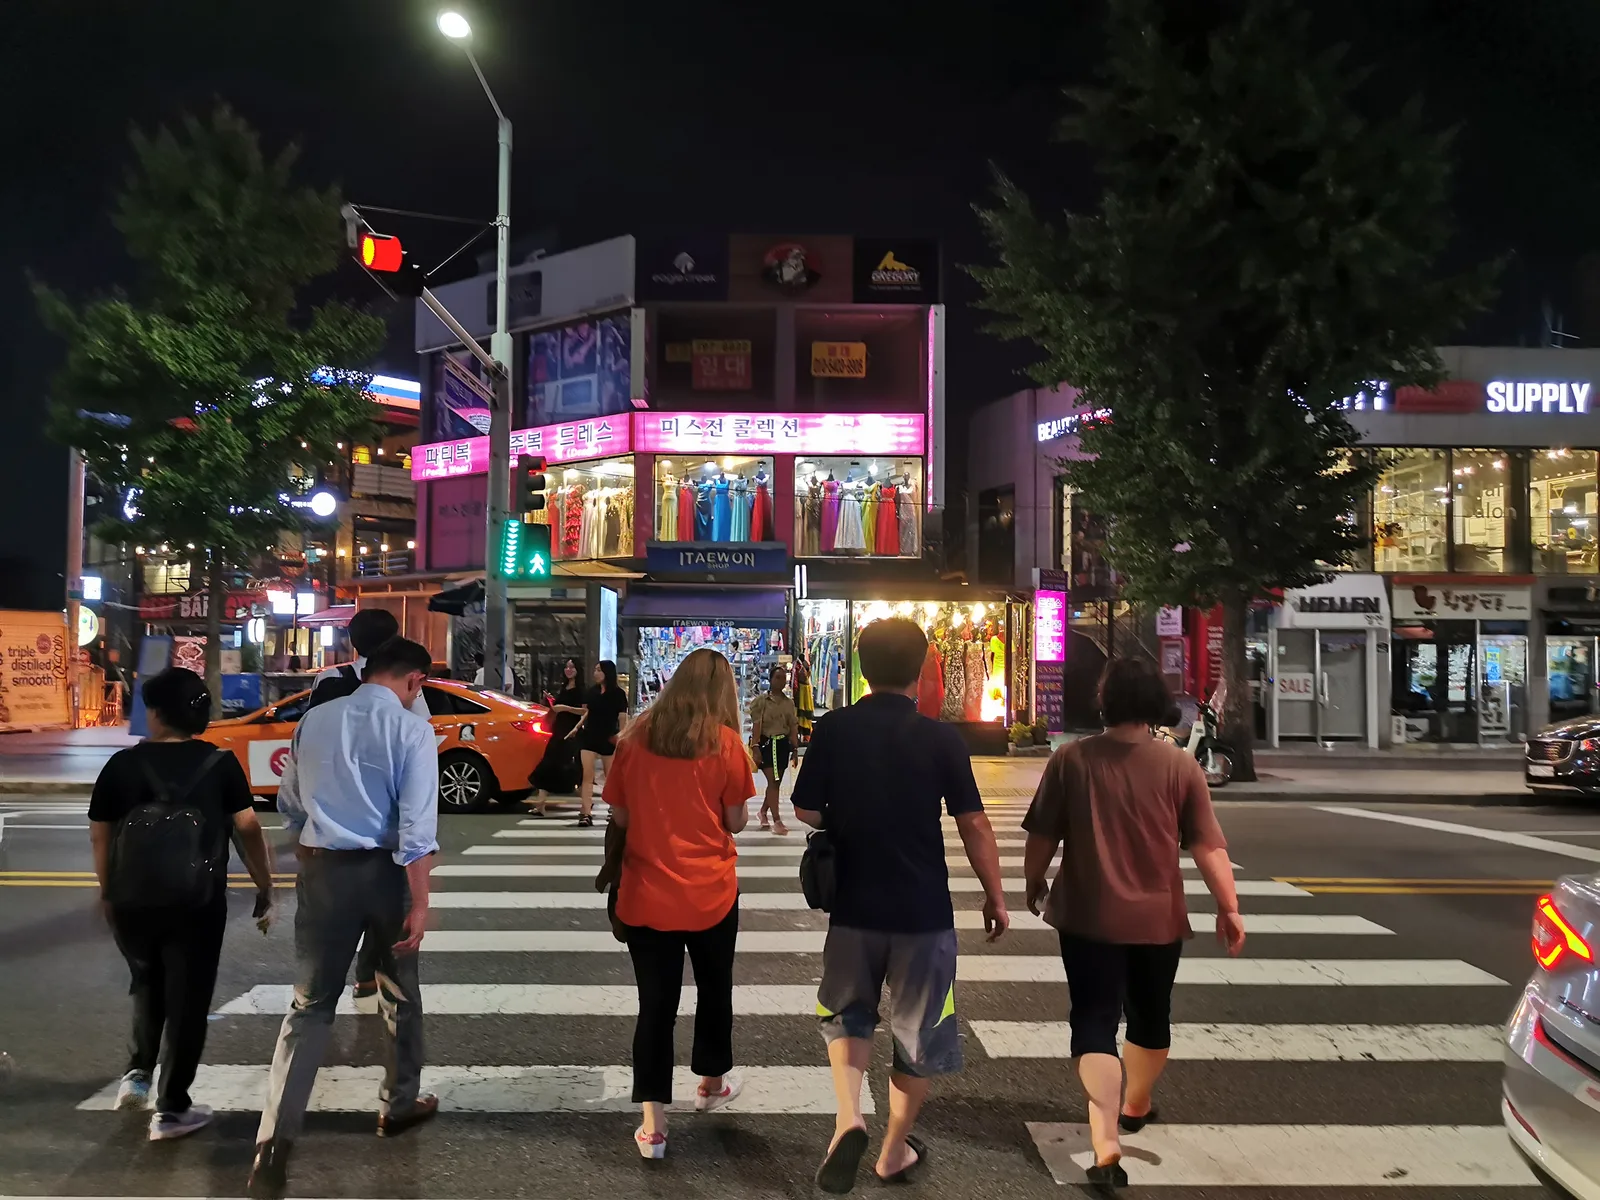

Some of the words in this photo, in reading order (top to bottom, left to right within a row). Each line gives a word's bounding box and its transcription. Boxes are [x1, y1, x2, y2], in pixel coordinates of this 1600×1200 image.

[1486, 381, 1591, 413] SUPPLY
[661, 417, 724, 438] 미스전
[733, 417, 799, 438] 콜렉션
[426, 443, 470, 465] 파티복
[510, 432, 542, 453] 주복
[560, 421, 613, 446] 드레스
[680, 552, 755, 567] ITAEWON
[673, 619, 709, 627] ITAEWON
[8, 646, 36, 660] triple
[11, 659, 52, 671] distilled
[12, 675, 54, 687] smooth
[1279, 678, 1312, 694] SALE
